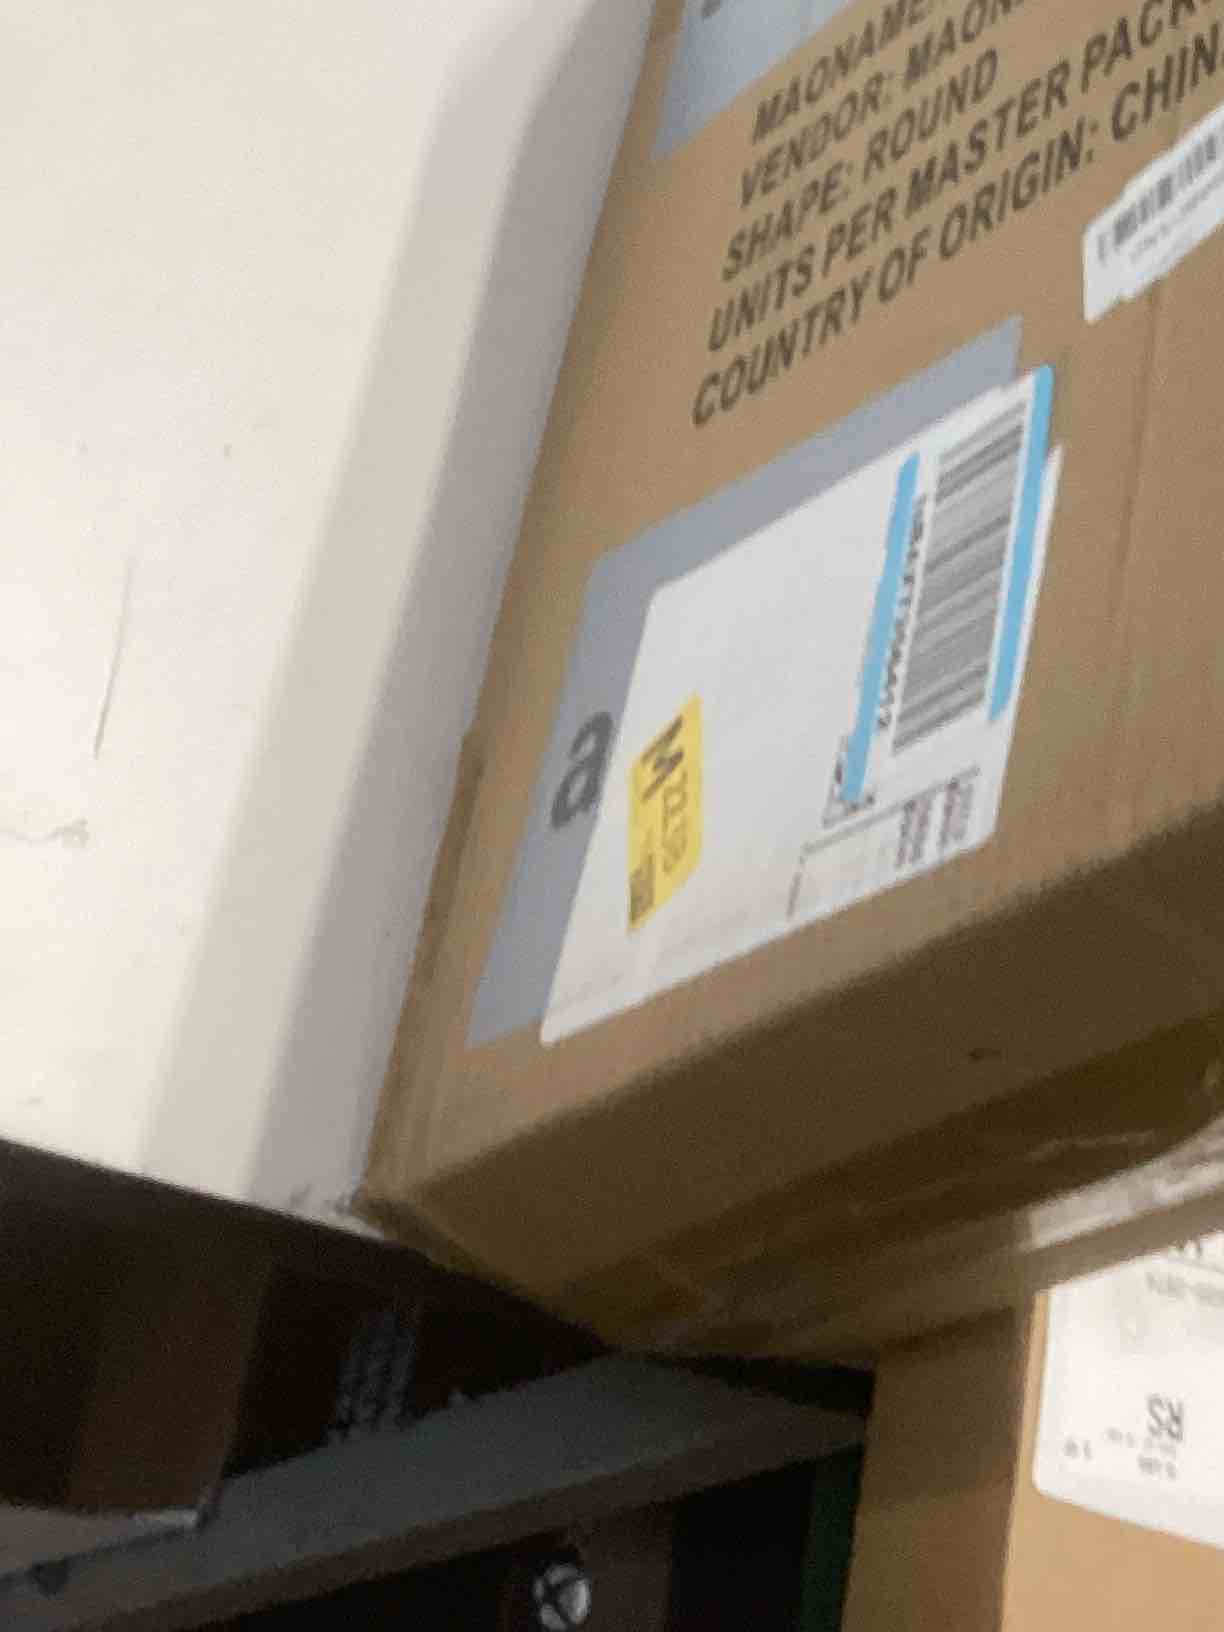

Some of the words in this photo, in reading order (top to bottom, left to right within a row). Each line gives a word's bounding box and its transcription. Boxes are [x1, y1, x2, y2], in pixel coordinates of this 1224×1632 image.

[690, 264, 876, 430] COUNTRY
[877, 226, 931, 305] OF
[938, 113, 1099, 262] ORIGIN:
[707, 244, 816, 353] UNITS
[822, 186, 899, 279] PER
[903, 60, 1072, 221] MASTER
[721, 159, 854, 284] SHAPE:
[863, 46, 999, 185] ROUND
[740, 69, 893, 210] VENDOR:
